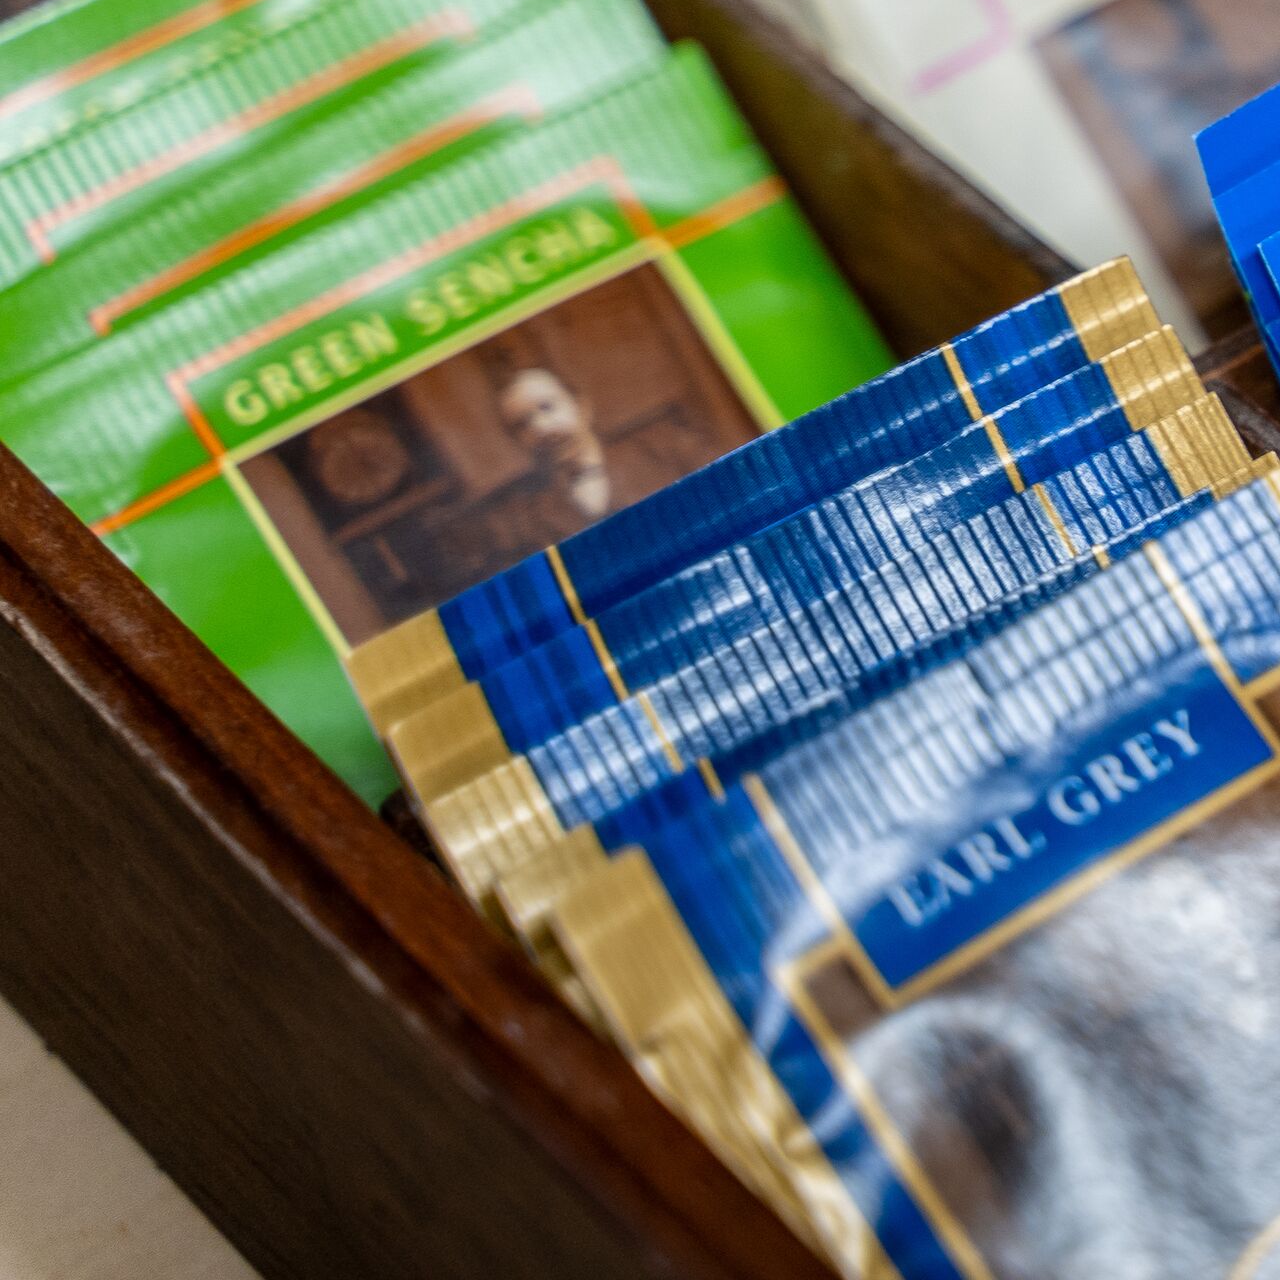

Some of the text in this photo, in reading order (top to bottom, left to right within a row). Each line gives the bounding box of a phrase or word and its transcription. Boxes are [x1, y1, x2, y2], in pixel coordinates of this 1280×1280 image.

[224, 207, 616, 426] GREEN SENCHA
[889, 709, 1200, 926] EARL GREY
